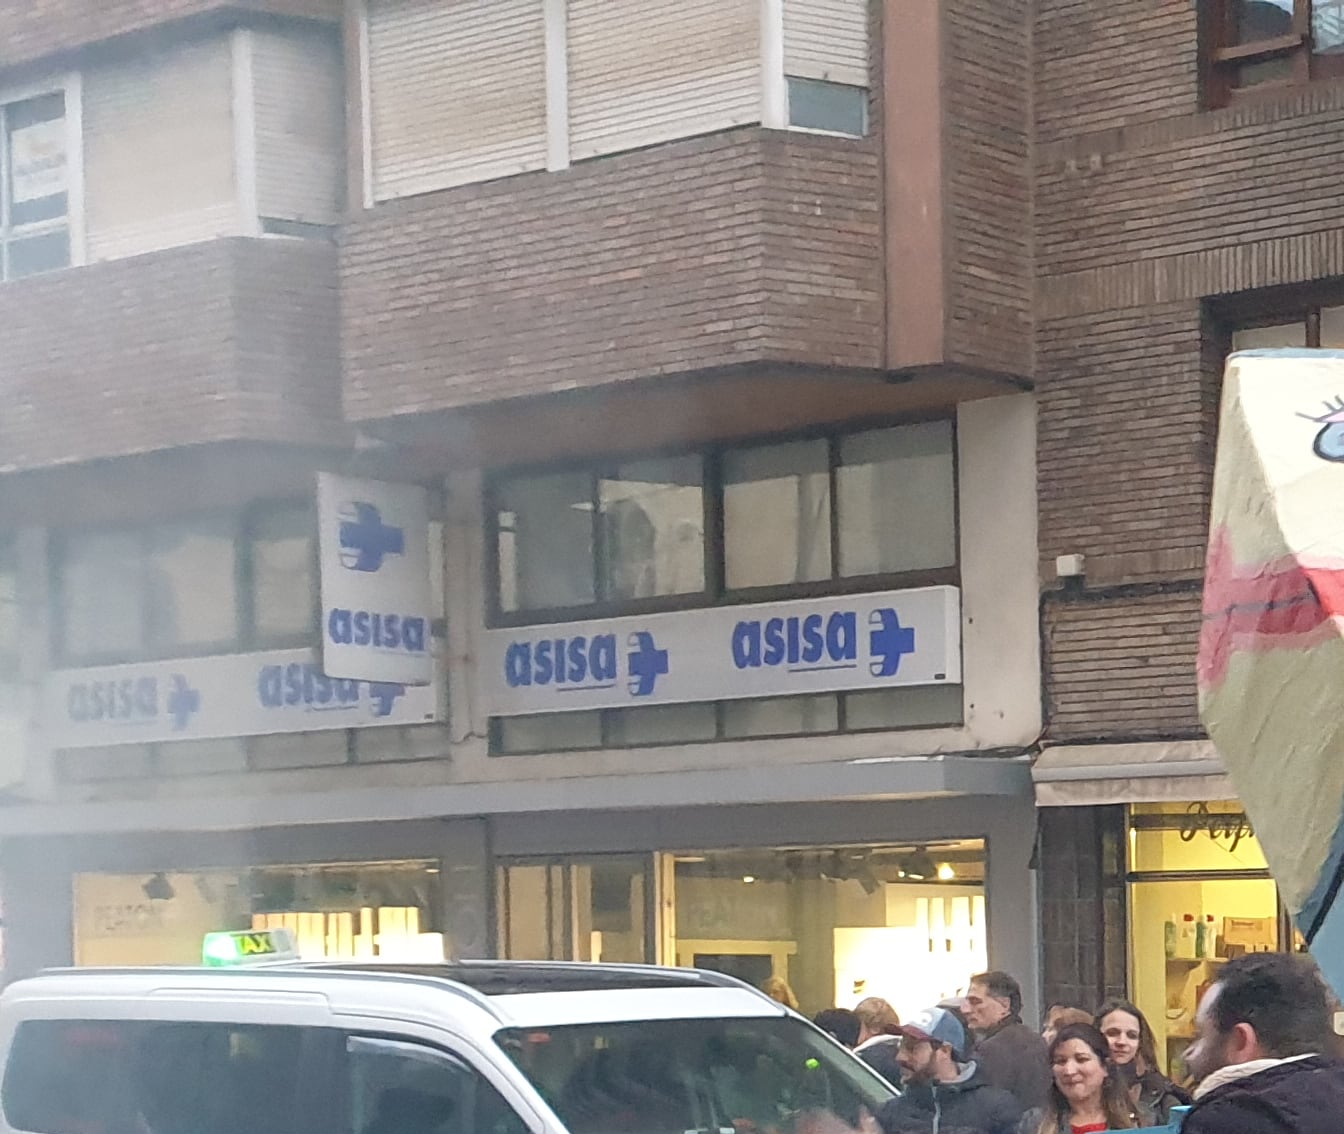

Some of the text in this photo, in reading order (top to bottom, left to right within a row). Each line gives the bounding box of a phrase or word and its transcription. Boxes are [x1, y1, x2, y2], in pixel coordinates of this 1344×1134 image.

[328, 607, 429, 653] asisa
[731, 609, 858, 670] asisa
[504, 633, 617, 688] asisa
[67, 675, 159, 723] asisa
